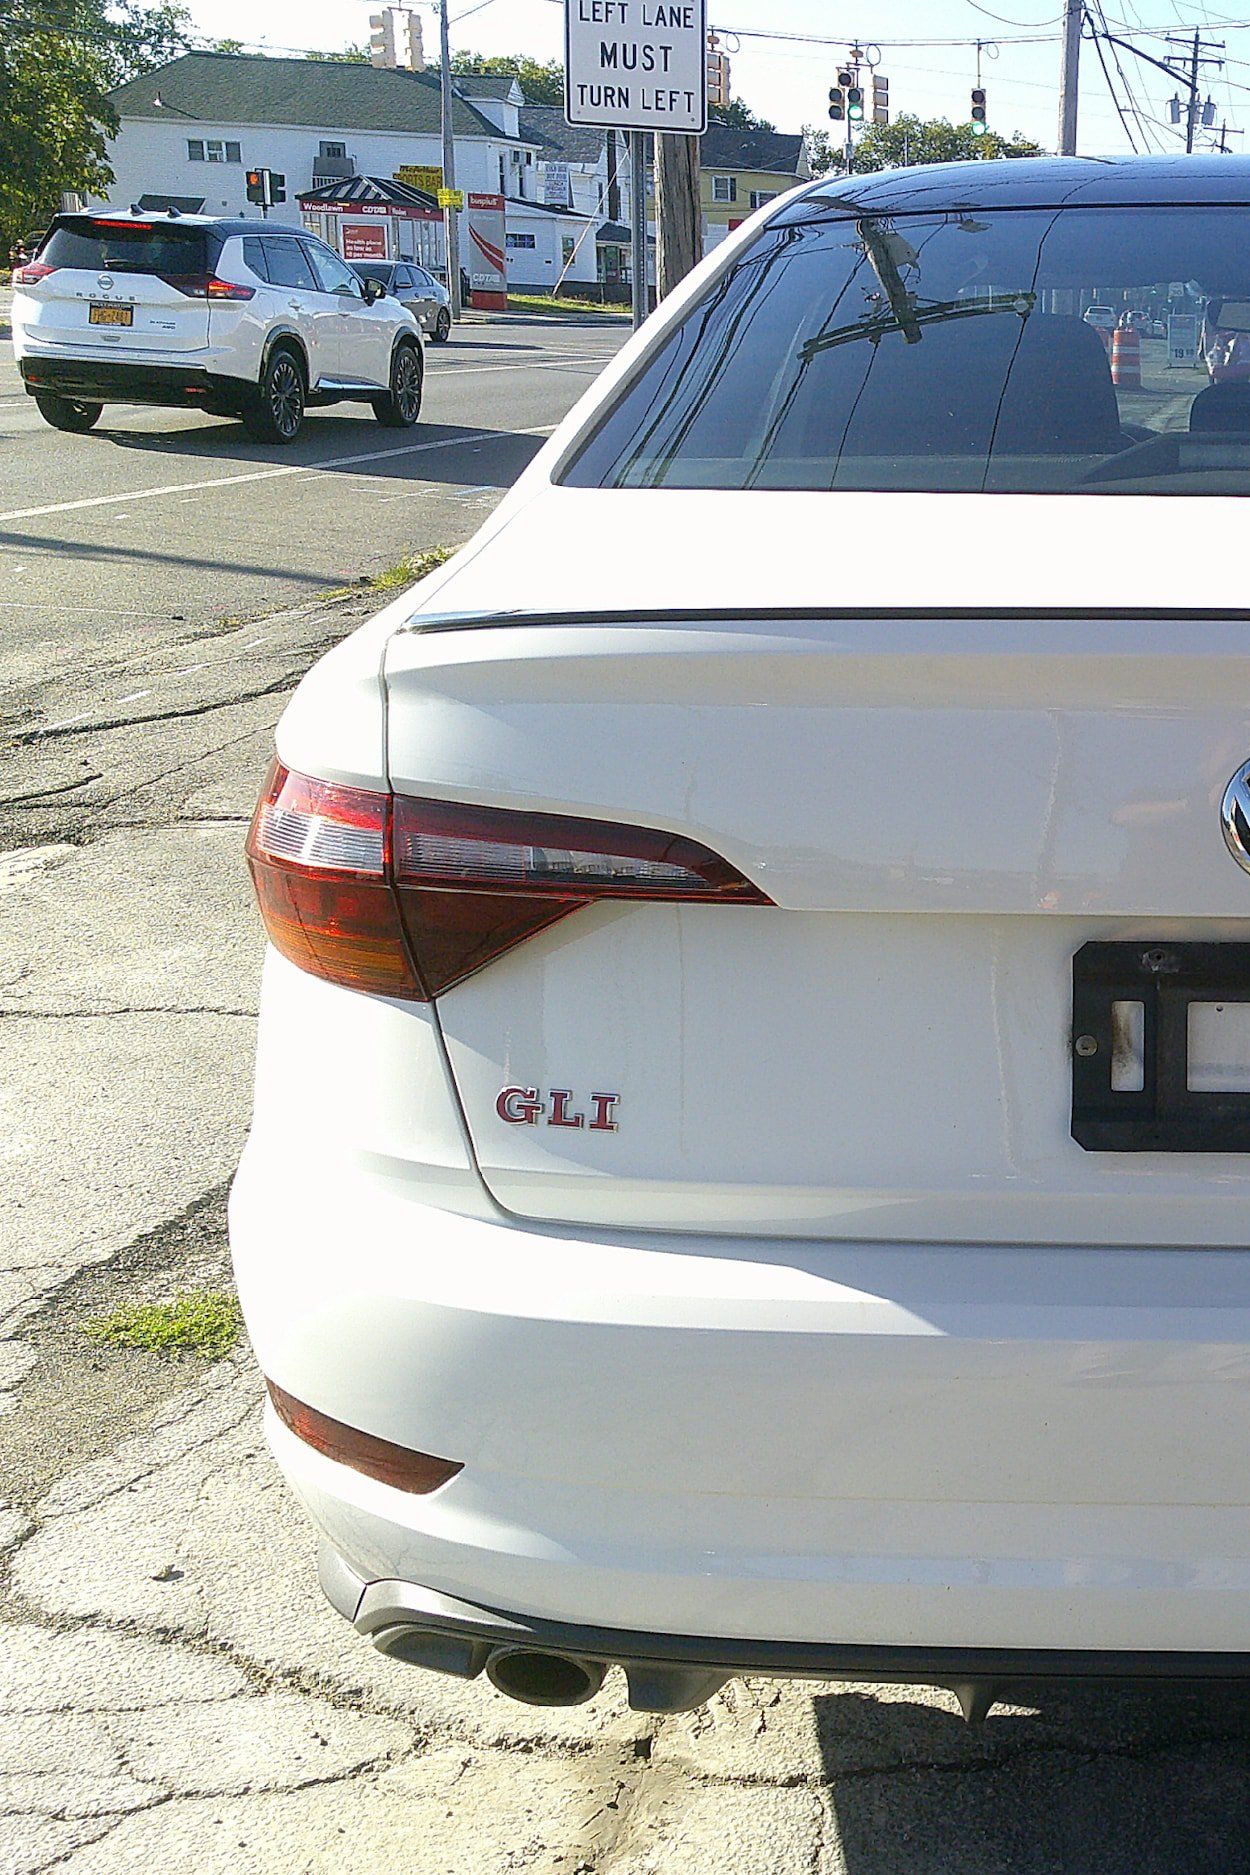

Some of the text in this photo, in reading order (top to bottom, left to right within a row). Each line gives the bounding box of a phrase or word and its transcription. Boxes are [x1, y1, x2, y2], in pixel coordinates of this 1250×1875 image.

[579, 0, 694, 29] LEFT LANE
[600, 41, 672, 72] MUST
[577, 84, 695, 113] TURN LEFT
[76, 292, 136, 301] ROGUE
[496, 1086, 619, 1132] GLI
